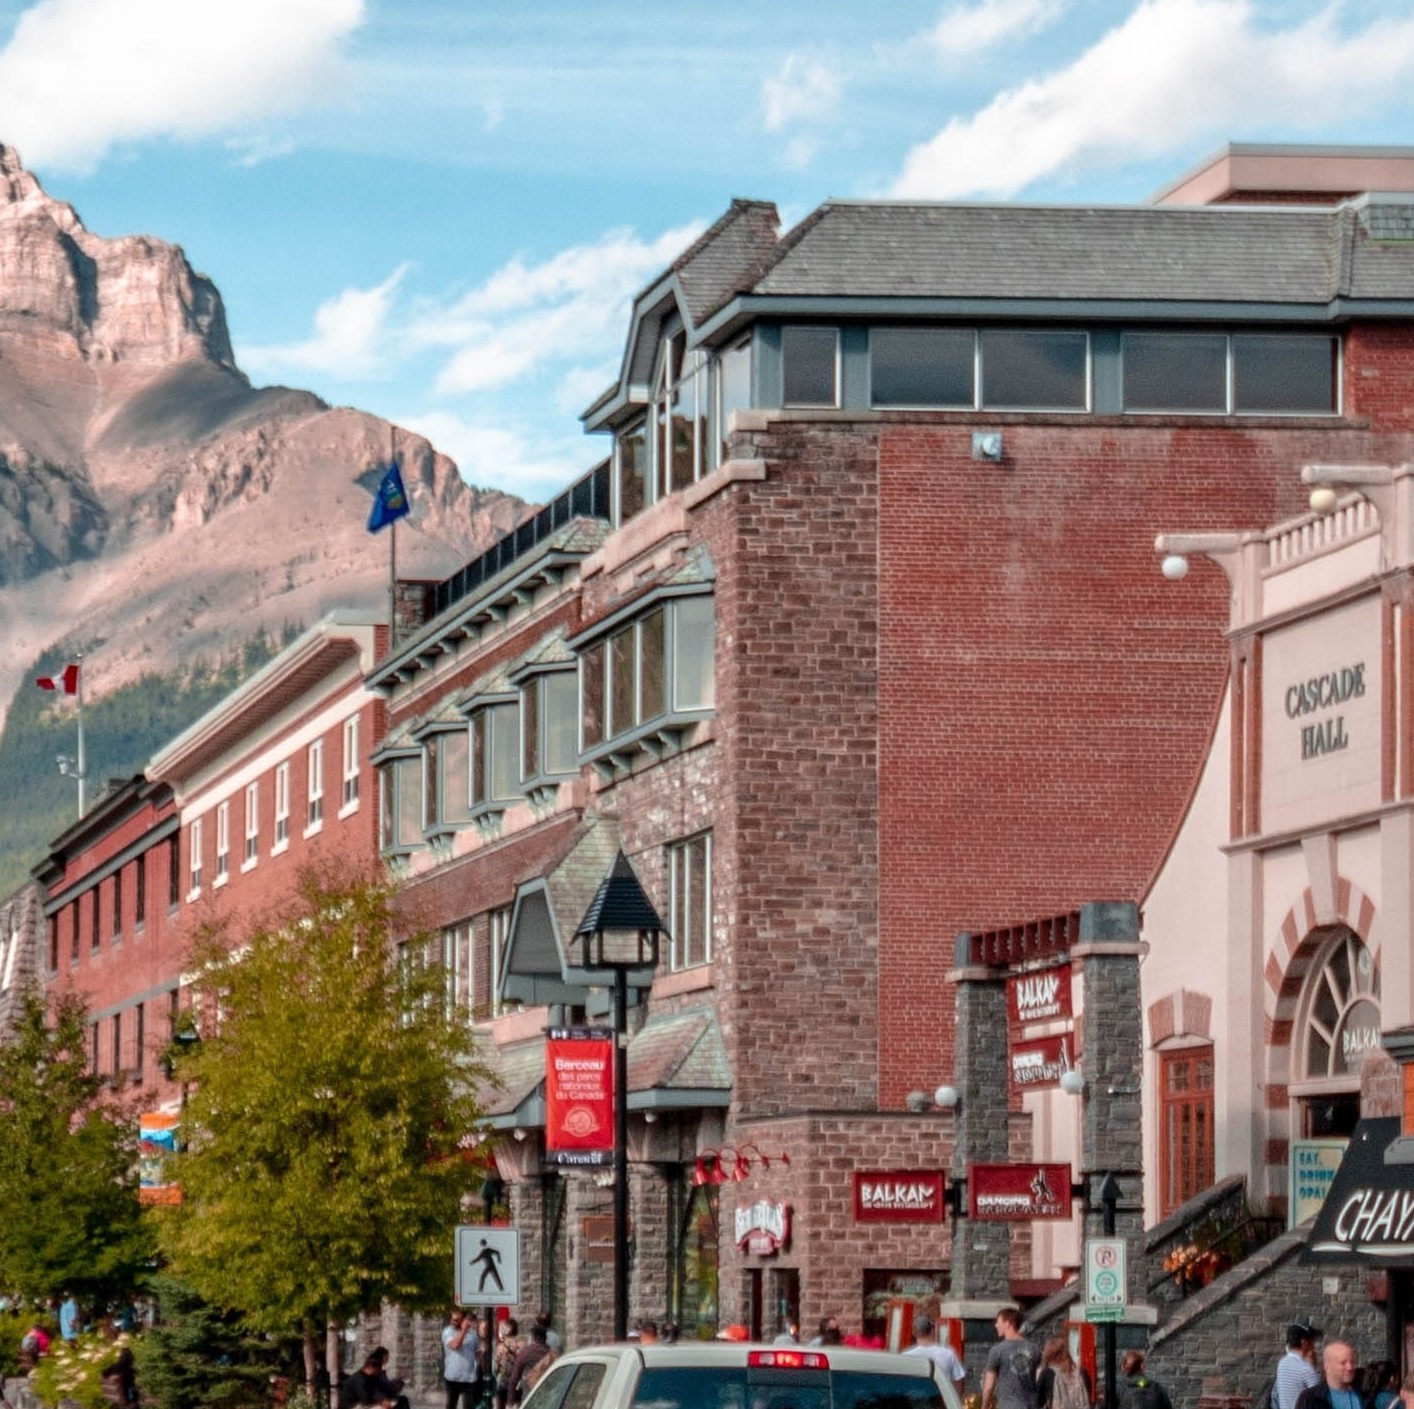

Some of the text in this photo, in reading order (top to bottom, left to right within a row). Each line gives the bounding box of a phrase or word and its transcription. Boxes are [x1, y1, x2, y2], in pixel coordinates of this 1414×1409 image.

[1284, 663, 1365, 720] CASCADE
[1301, 716, 1349, 761] HALL
[1017, 974, 1059, 1010] BALKAN
[555, 1058, 605, 1071] Berceau
[861, 1182, 934, 1203] BALKAN
[977, 1195, 1031, 1206] DANCING
[1335, 1188, 1414, 1242] CHAY
